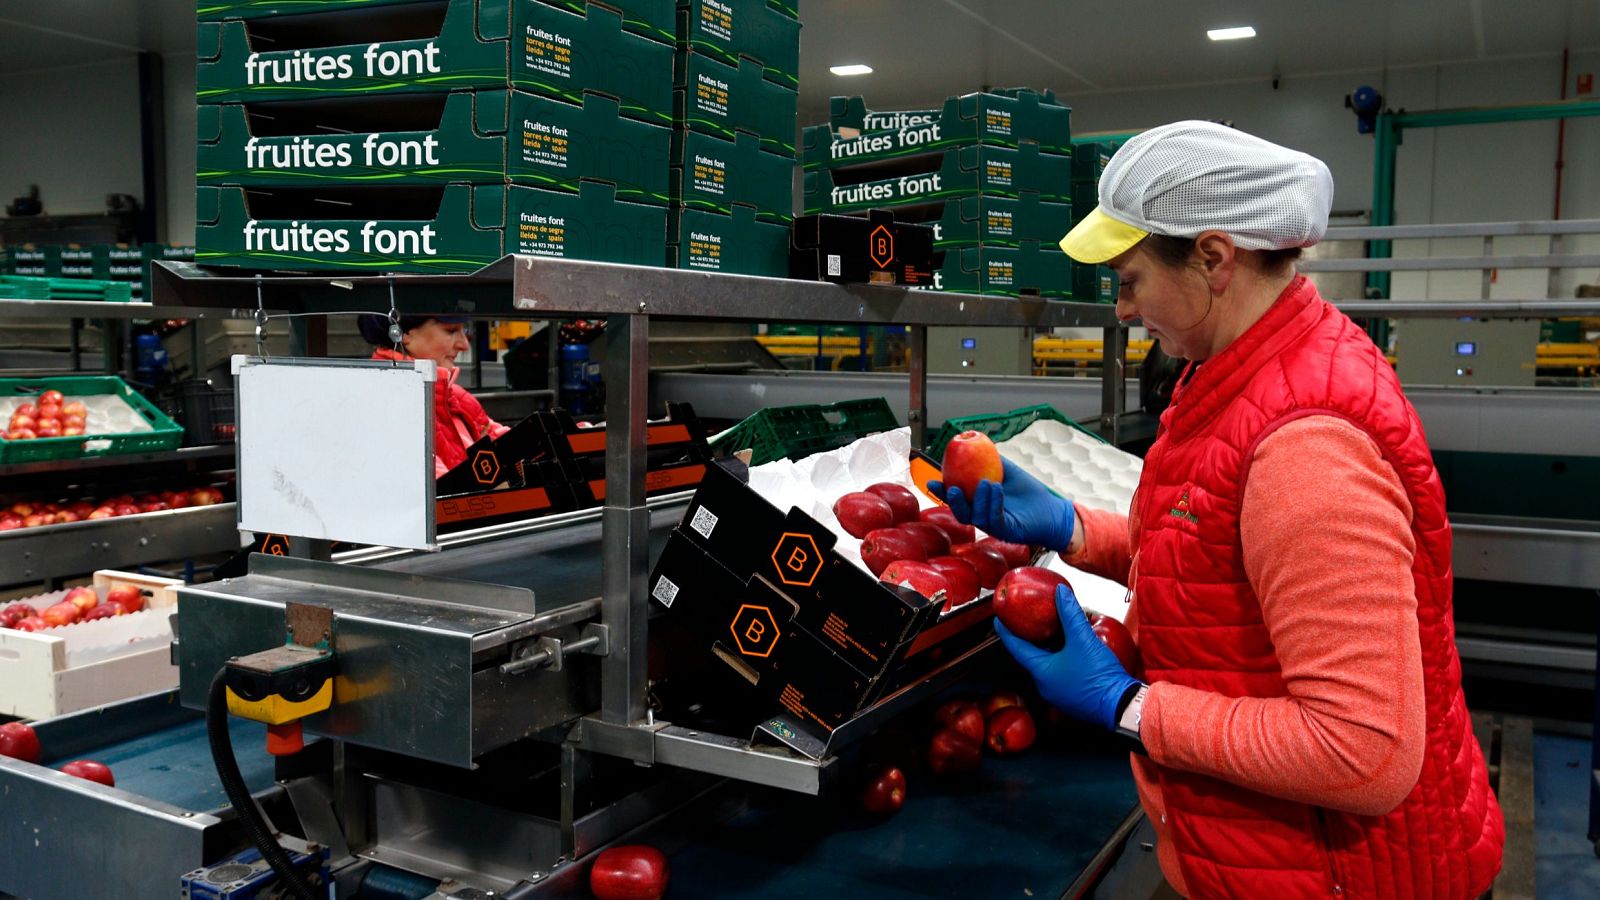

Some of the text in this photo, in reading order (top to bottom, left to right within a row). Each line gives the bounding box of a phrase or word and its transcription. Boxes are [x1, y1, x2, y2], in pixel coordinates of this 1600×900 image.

[526, 25, 570, 46] fruites font
[526, 37, 544, 47] torres
[555, 46, 570, 55] segre
[526, 45, 570, 62] lleida spain
[245, 42, 441, 84] fruites font
[699, 74, 728, 90] fruites font
[524, 120, 568, 137] fruites font
[863, 113, 932, 129] fruites
[524, 131, 542, 140] torres
[524, 139, 540, 148] lleida
[830, 124, 941, 159] fruites font
[245, 134, 439, 168] fruites font
[696, 155, 725, 168] fruites font
[831, 174, 941, 205] fruites font
[520, 213, 564, 226] fruites font
[243, 221, 437, 255] fruites font
[691, 232, 720, 243] fruites font
[878, 239, 886, 255] B
[480, 458, 492, 475] B
[442, 496, 496, 515] BLISS
[787, 547, 807, 572] B
[745, 618, 765, 643] B
